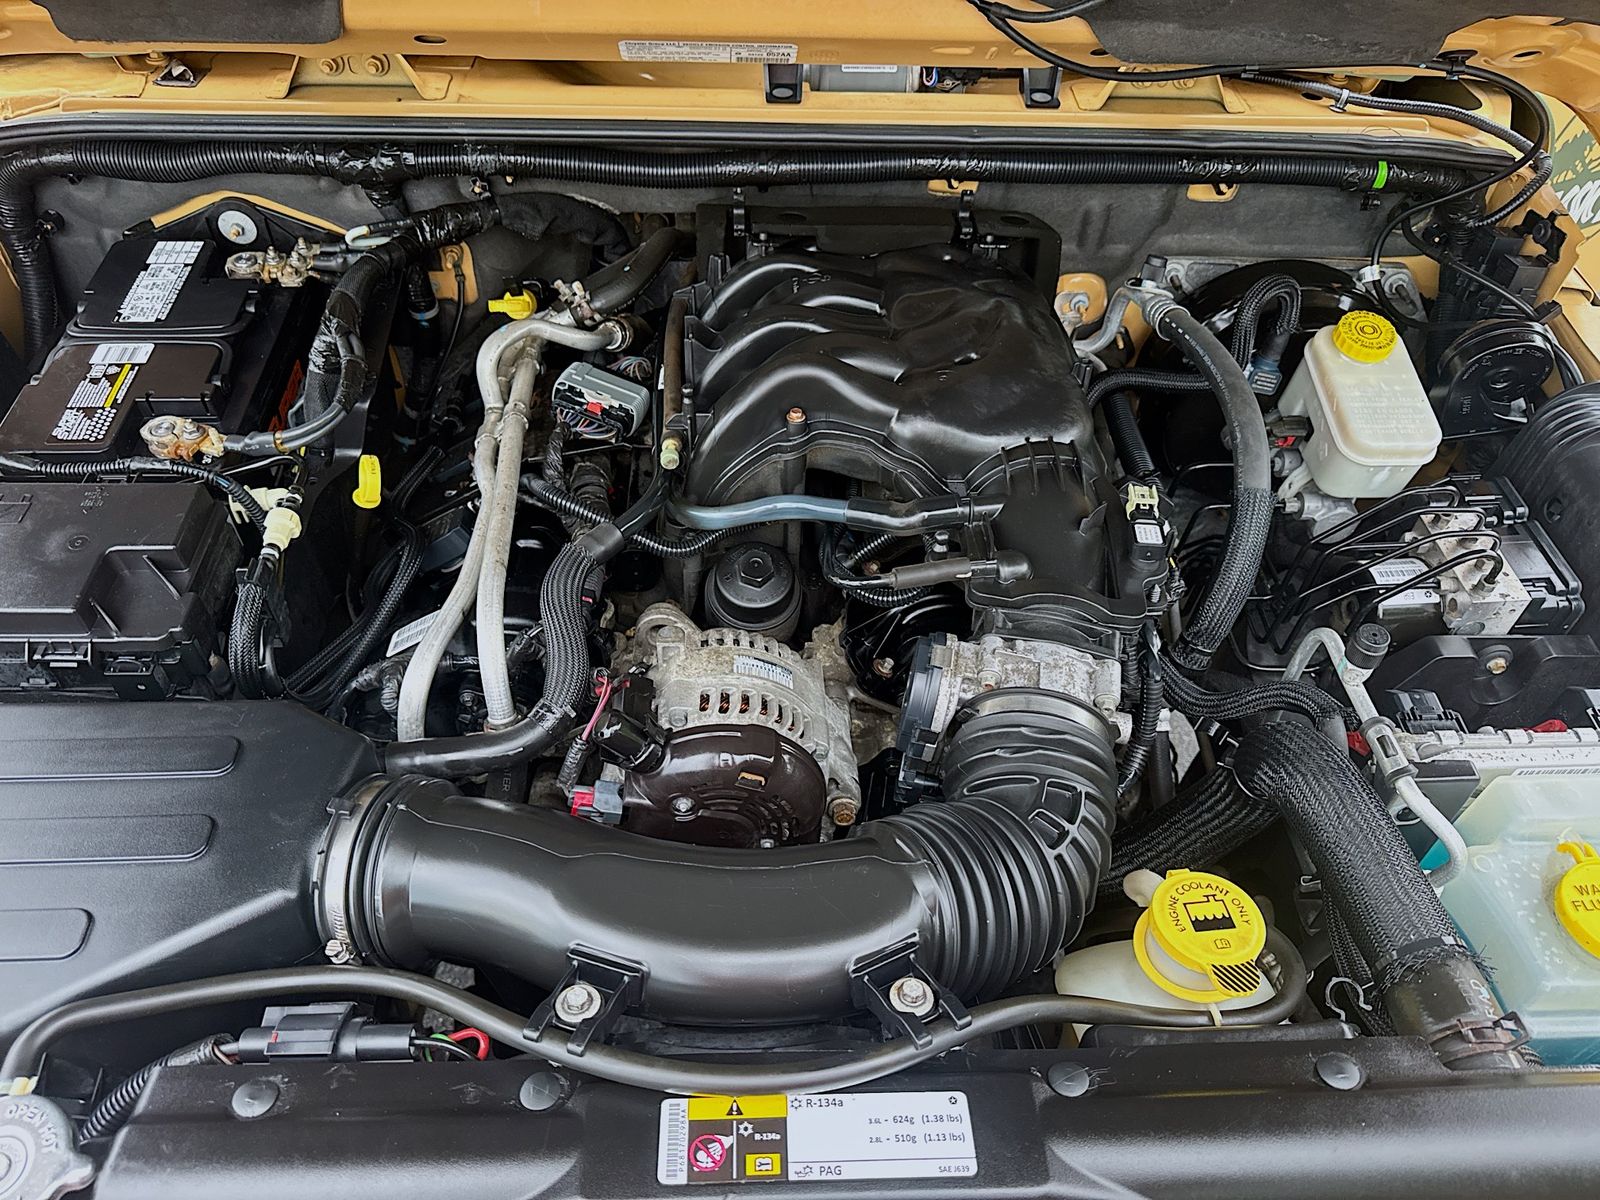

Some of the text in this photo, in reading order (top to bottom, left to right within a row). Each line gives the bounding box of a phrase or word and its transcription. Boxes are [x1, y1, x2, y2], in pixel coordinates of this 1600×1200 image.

[1168, 881, 1251, 933] ENGINE COOLANT ONLY
[805, 1097, 844, 1108] R-134a
[892, 1115, 915, 1125] 624g
[921, 1114, 944, 1125] (1.38
[946, 1113, 963, 1124] lbs)
[894, 1134, 917, 1144] 510g
[923, 1133, 947, 1144] (1.13
[949, 1132, 966, 1143] lbs)
[819, 1166, 842, 1176] PAG
[953, 1165, 970, 1173] J639
